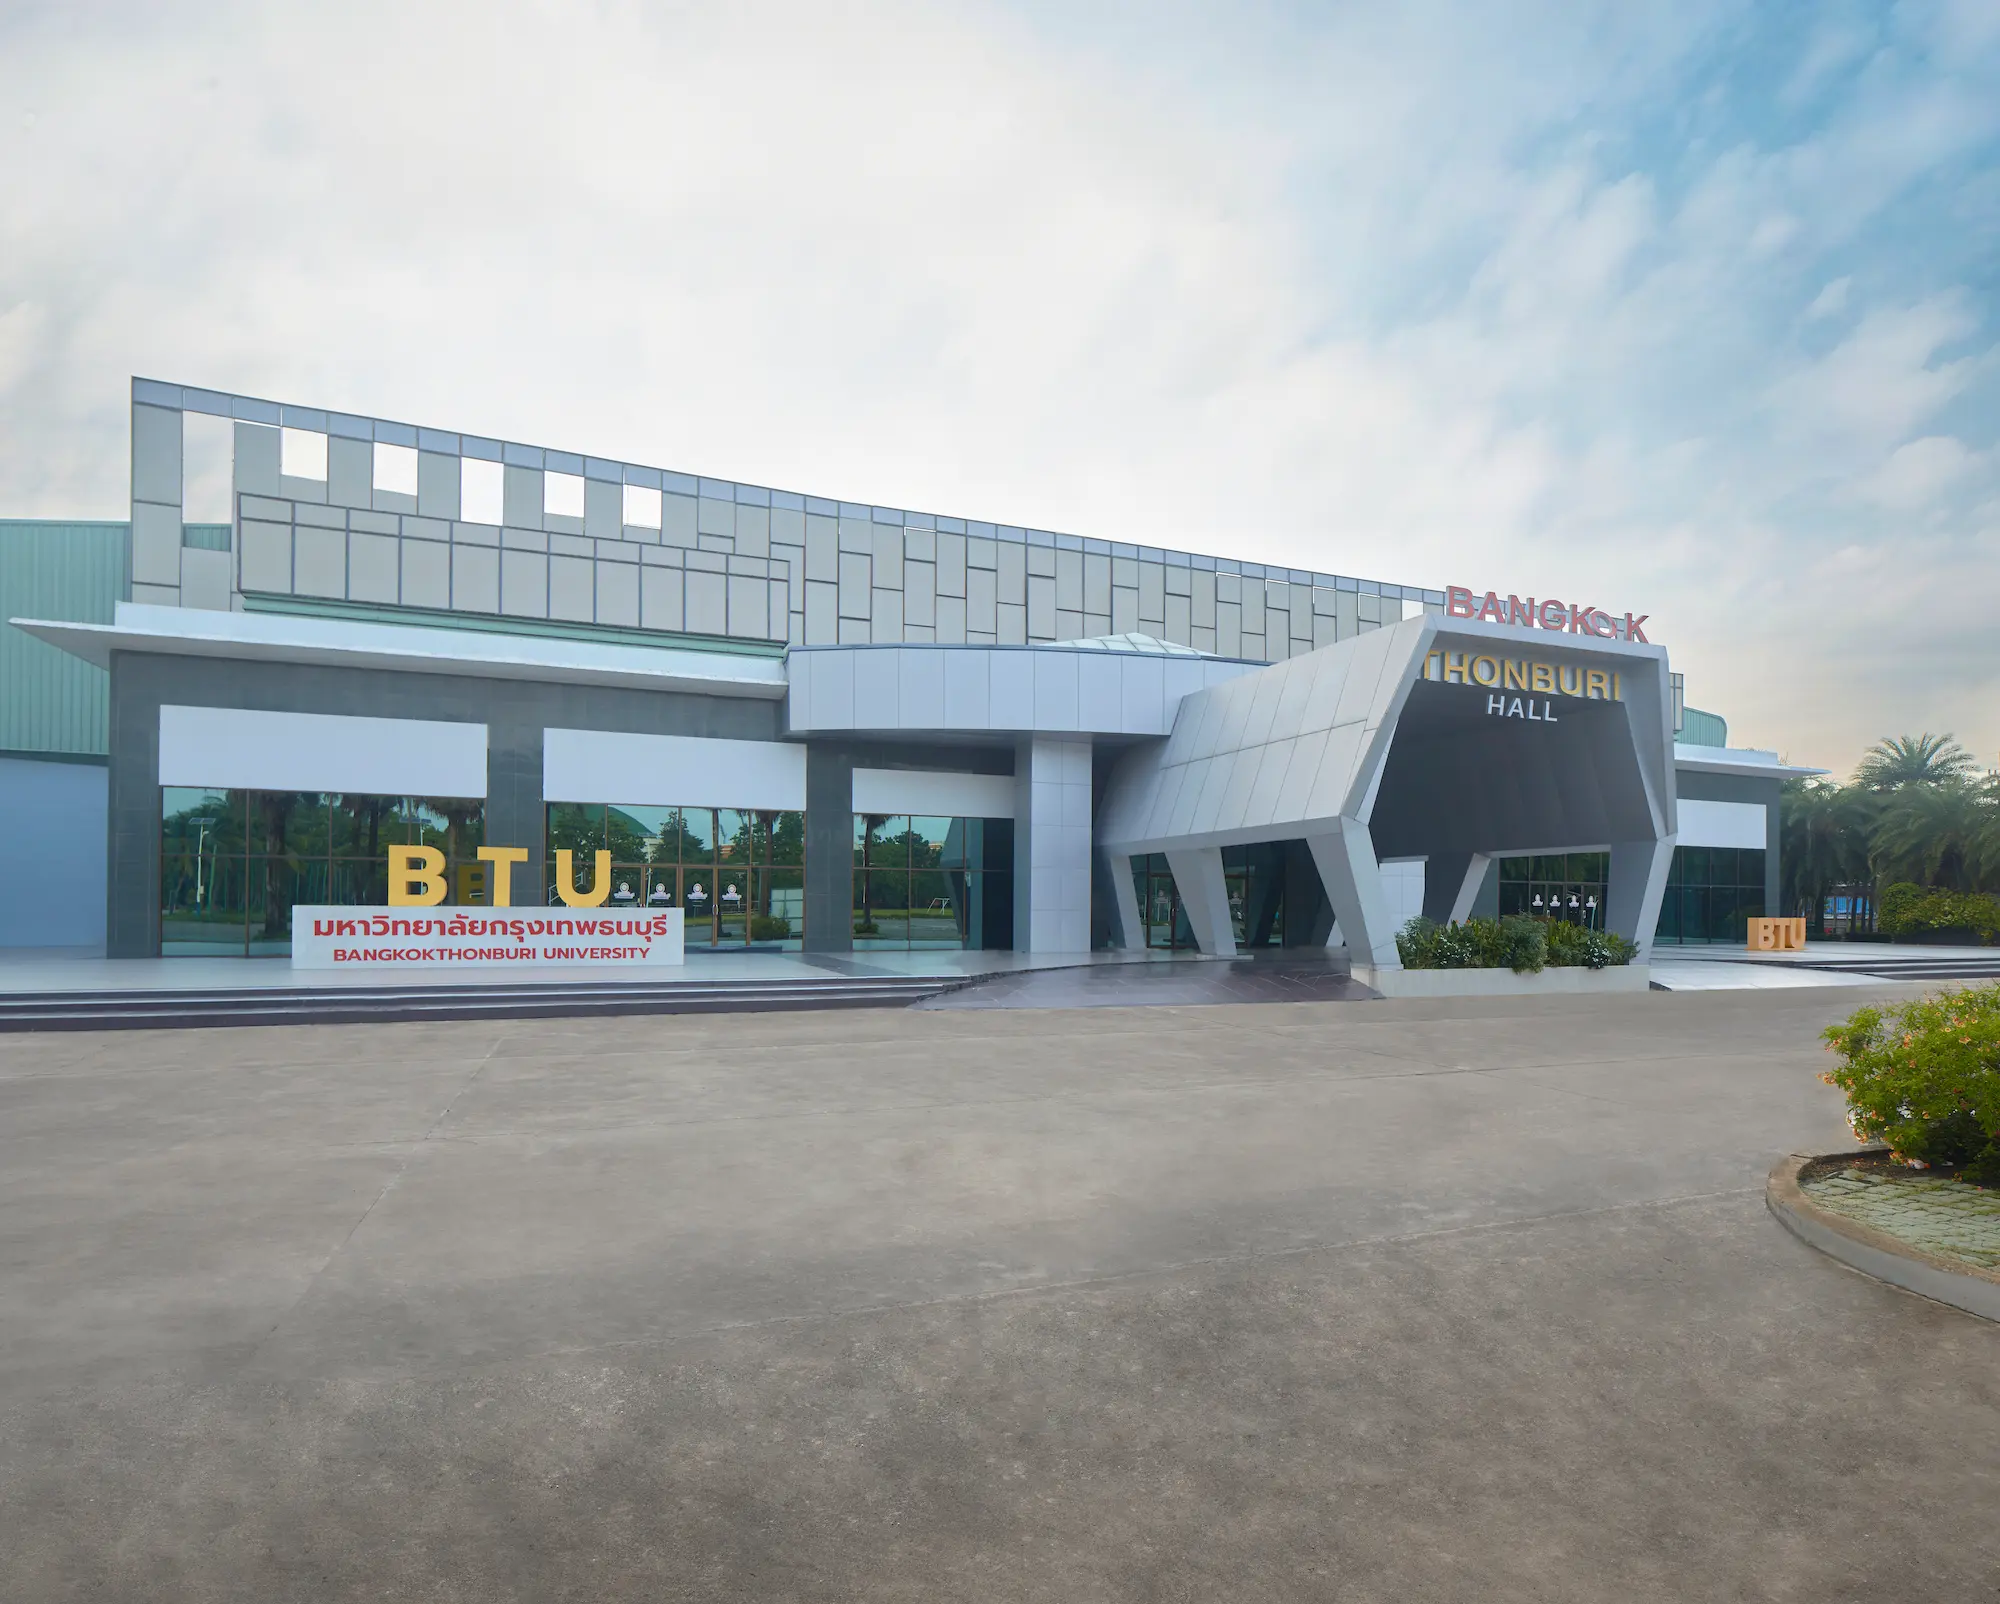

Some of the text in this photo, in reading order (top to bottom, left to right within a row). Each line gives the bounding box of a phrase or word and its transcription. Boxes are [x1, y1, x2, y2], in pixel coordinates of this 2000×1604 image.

[1446, 585, 1650, 644] BANGKOK
[1423, 649, 1621, 701] THONBURI
[1487, 694, 1558, 722] HALL
[388, 844, 612, 907] BTU
[314, 914, 667, 943] มหาวิทยาลัยกรุงเทพธนบุรี
[1756, 917, 1807, 950] BTU
[333, 947, 651, 962] BANGKOKTHONBURI UNIVERSITY
